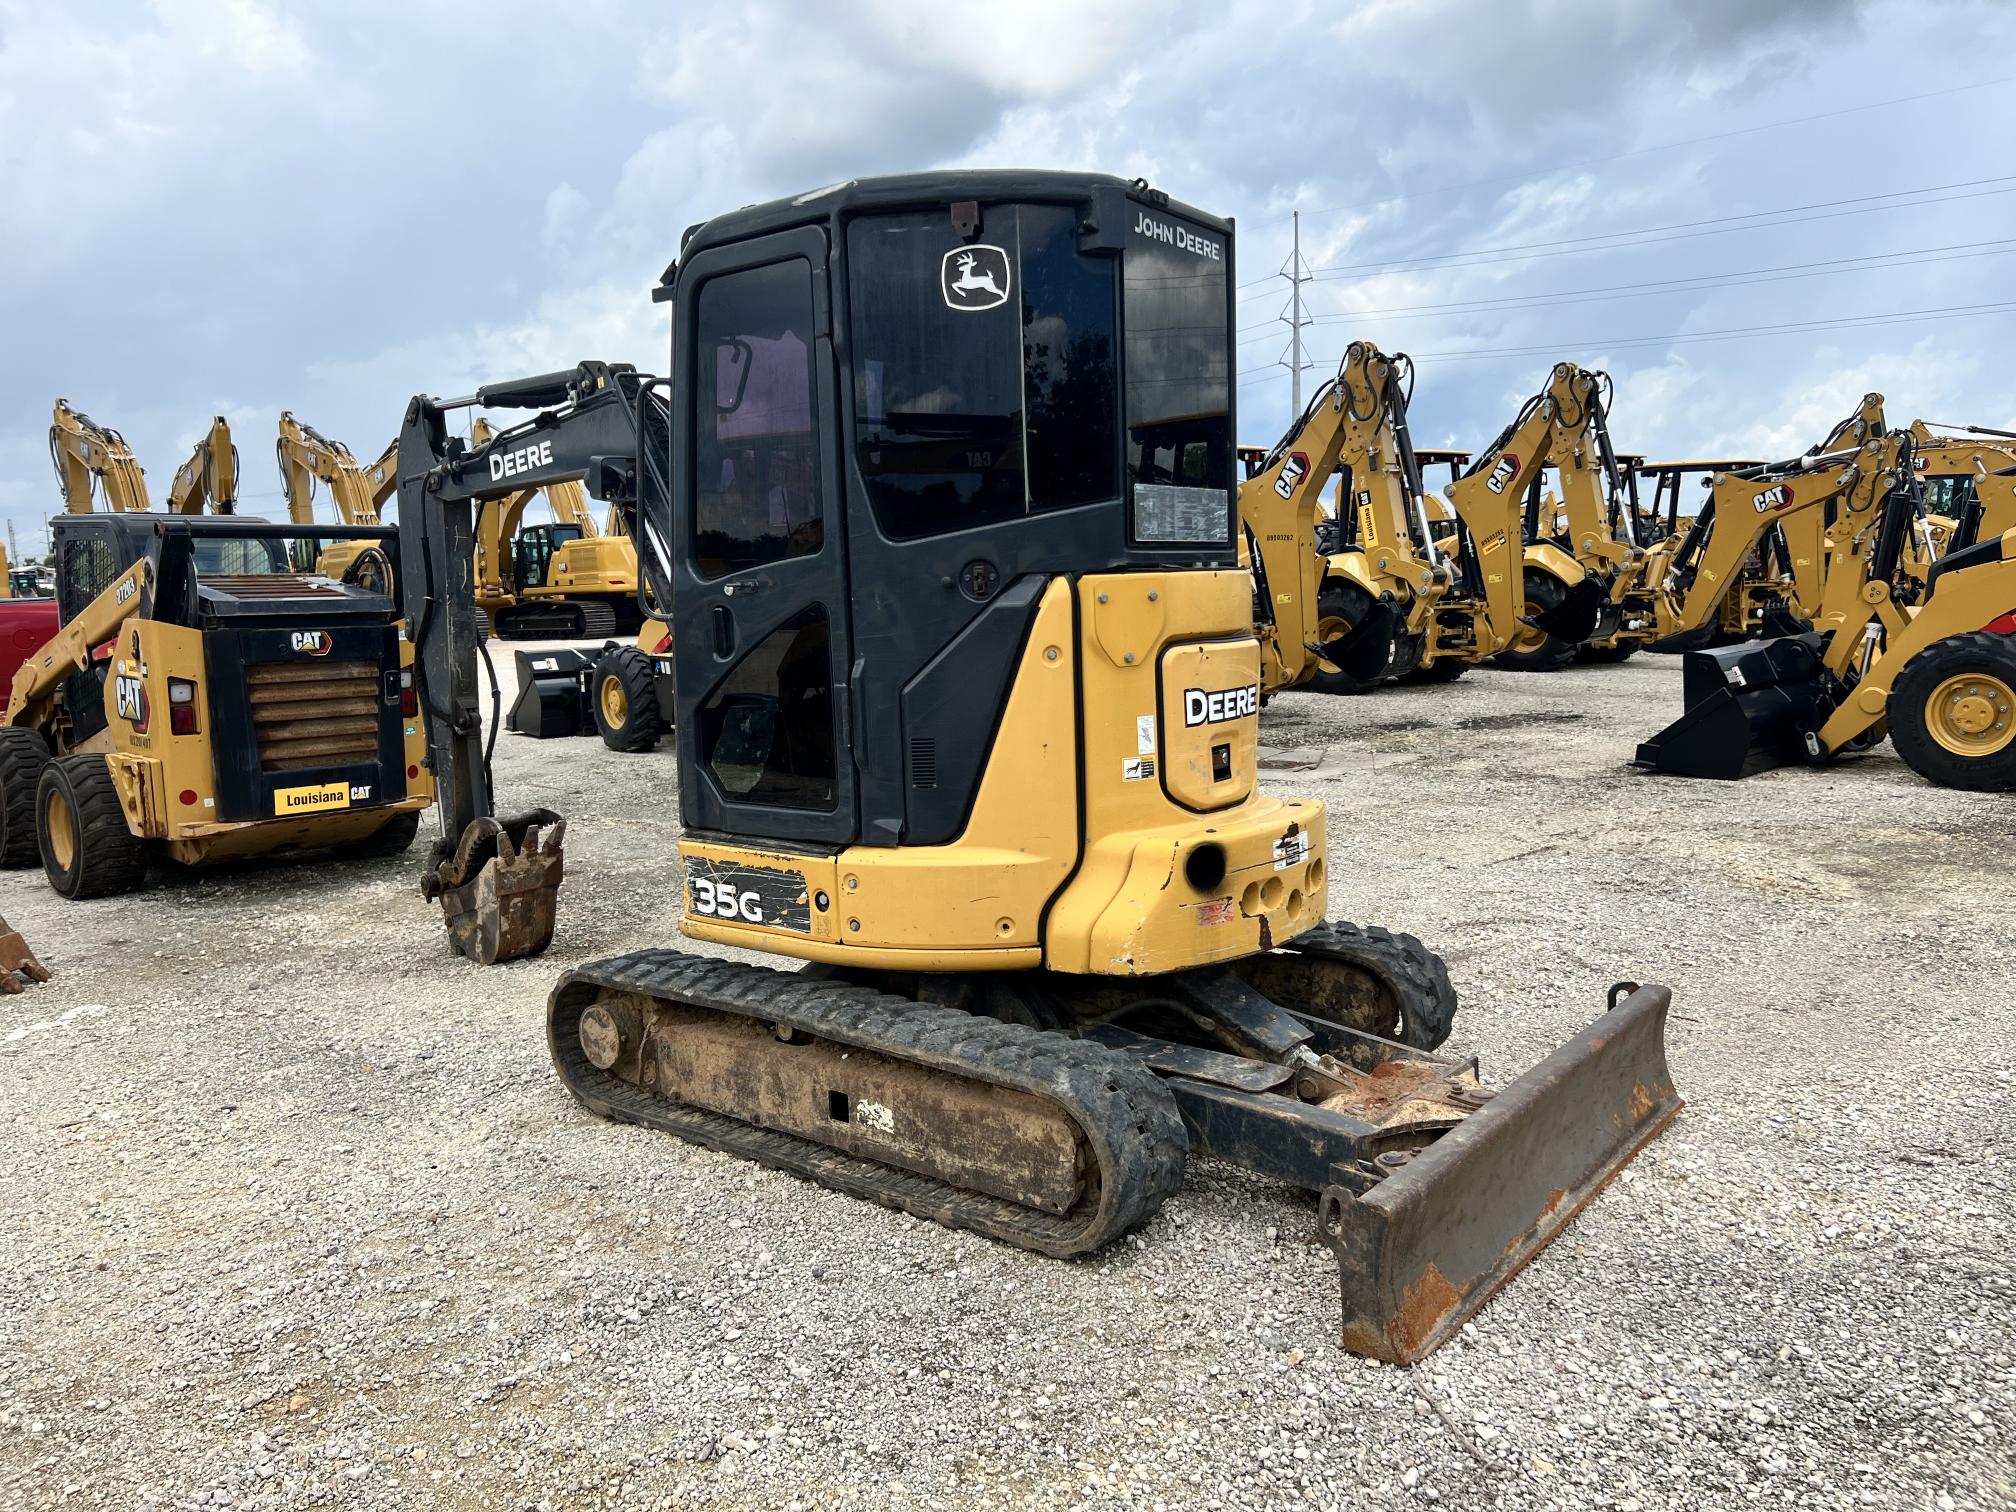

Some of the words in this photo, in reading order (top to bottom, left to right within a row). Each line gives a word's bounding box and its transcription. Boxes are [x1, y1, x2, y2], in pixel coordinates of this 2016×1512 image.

[1134, 212, 1173, 245] JOHN
[1176, 226, 1220, 260] DEERE
[489, 440, 554, 481] DEERE
[1274, 456, 1304, 500] CAT
[1486, 458, 1515, 494] CAT
[1752, 485, 1785, 513] CAT
[1365, 507, 1375, 541] Louisiana
[291, 631, 322, 651] CAT
[116, 676, 141, 721] CAT
[1184, 685, 1257, 727] DEERE
[287, 790, 344, 806] Louisiana
[350, 785, 373, 800] CAT
[695, 877, 763, 922] 35G
